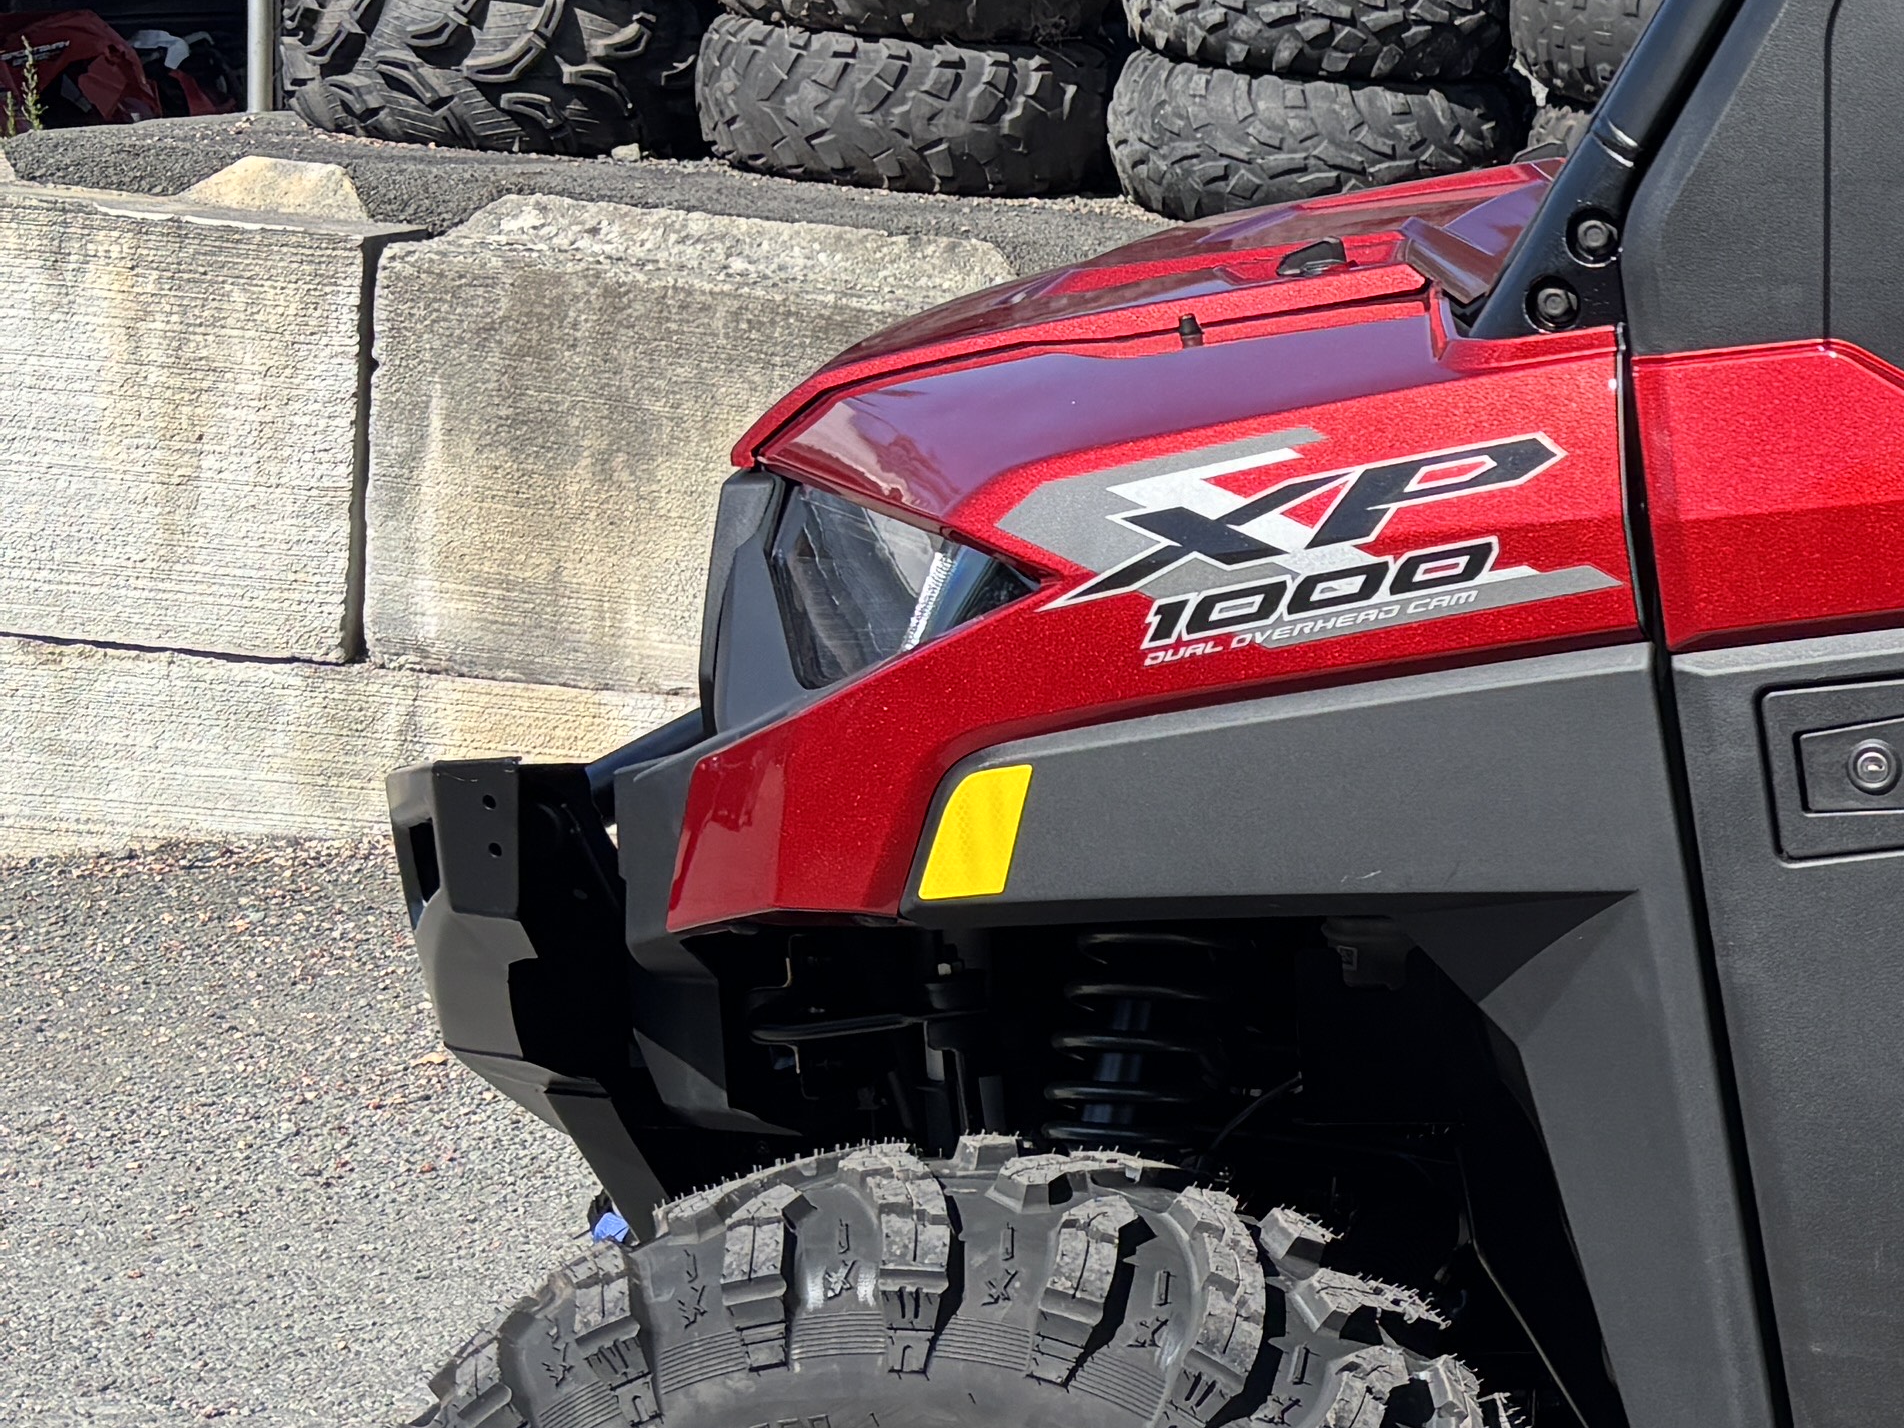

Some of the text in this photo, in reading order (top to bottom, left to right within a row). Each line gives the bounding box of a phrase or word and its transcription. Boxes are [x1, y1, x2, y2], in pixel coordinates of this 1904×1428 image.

[1036, 431, 1568, 612] XP
[1141, 536, 1499, 650] 1000
[1144, 590, 1479, 667] DUAL OVERHEAD CAM
